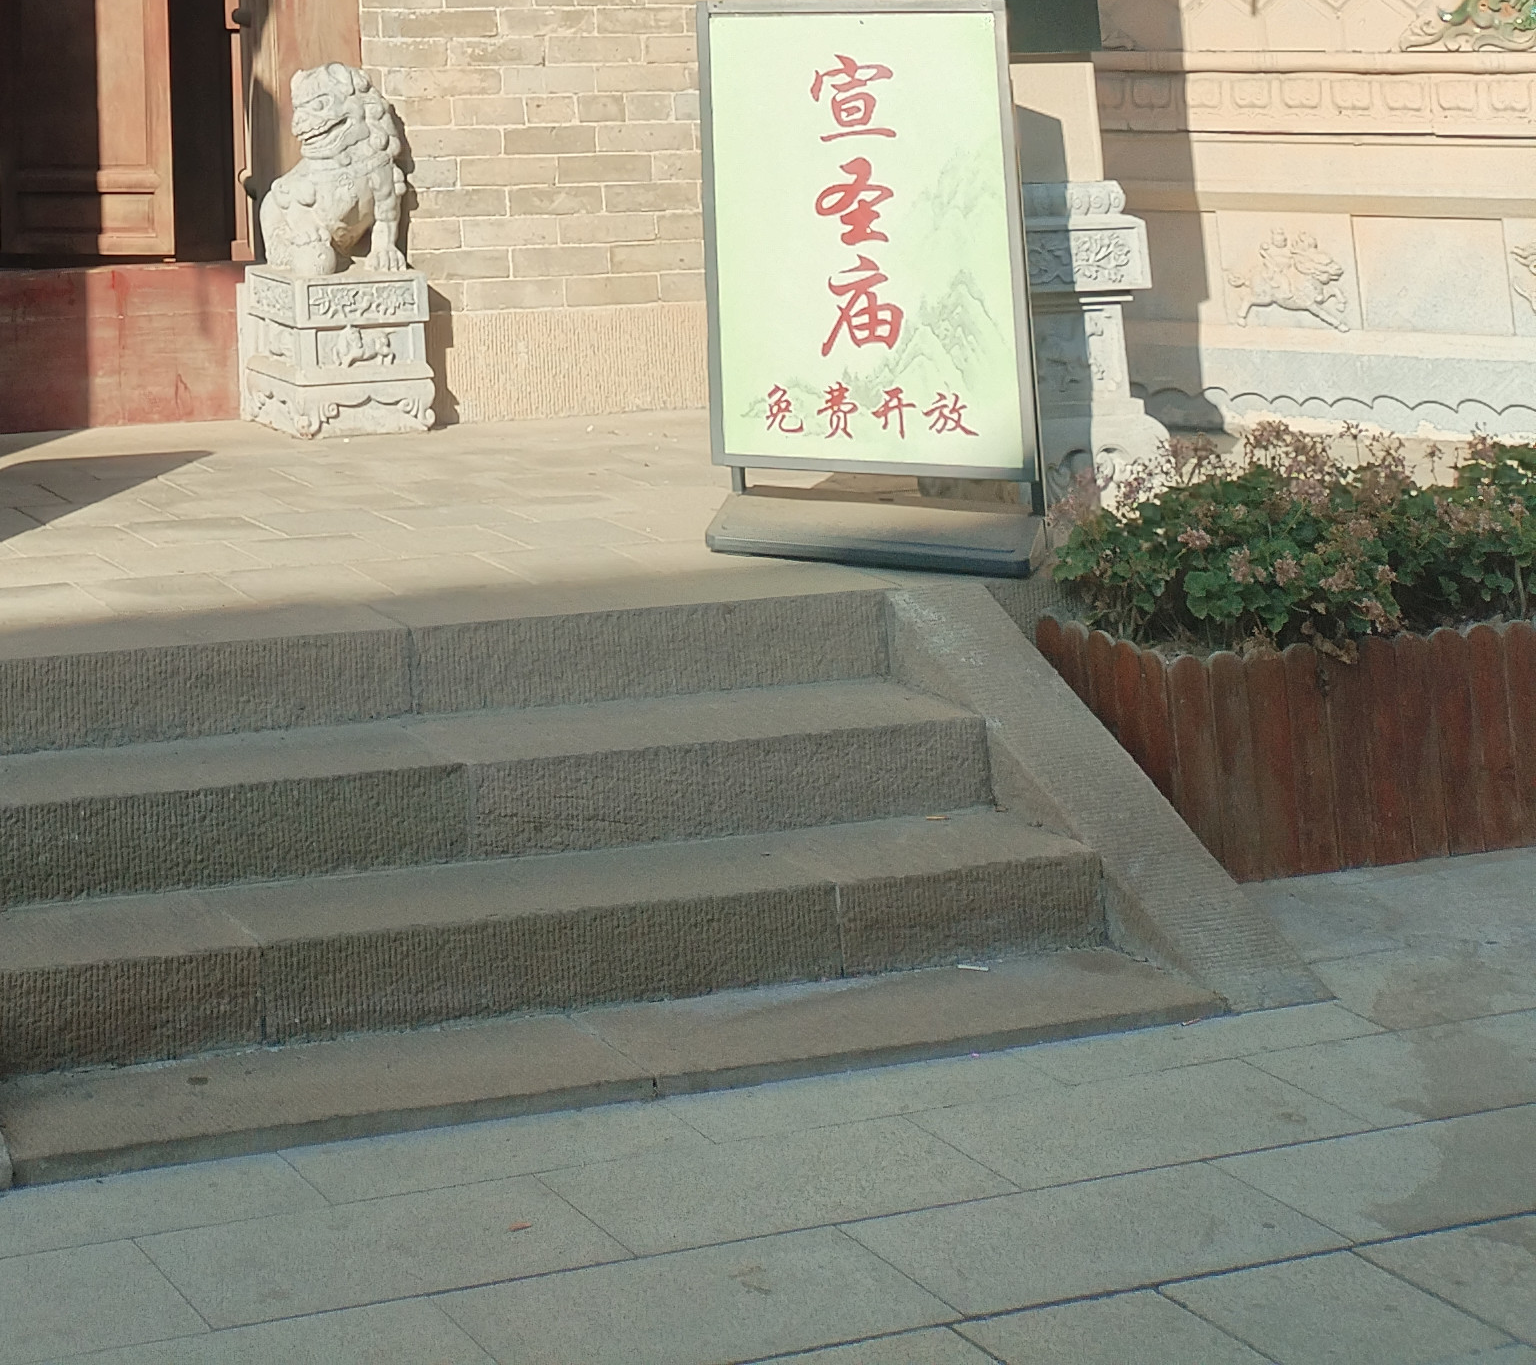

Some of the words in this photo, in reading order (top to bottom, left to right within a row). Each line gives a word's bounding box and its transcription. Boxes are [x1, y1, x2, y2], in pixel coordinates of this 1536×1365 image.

[810, 54, 904, 357] 宣圣庙
[764, 380, 981, 440] 免费开放
